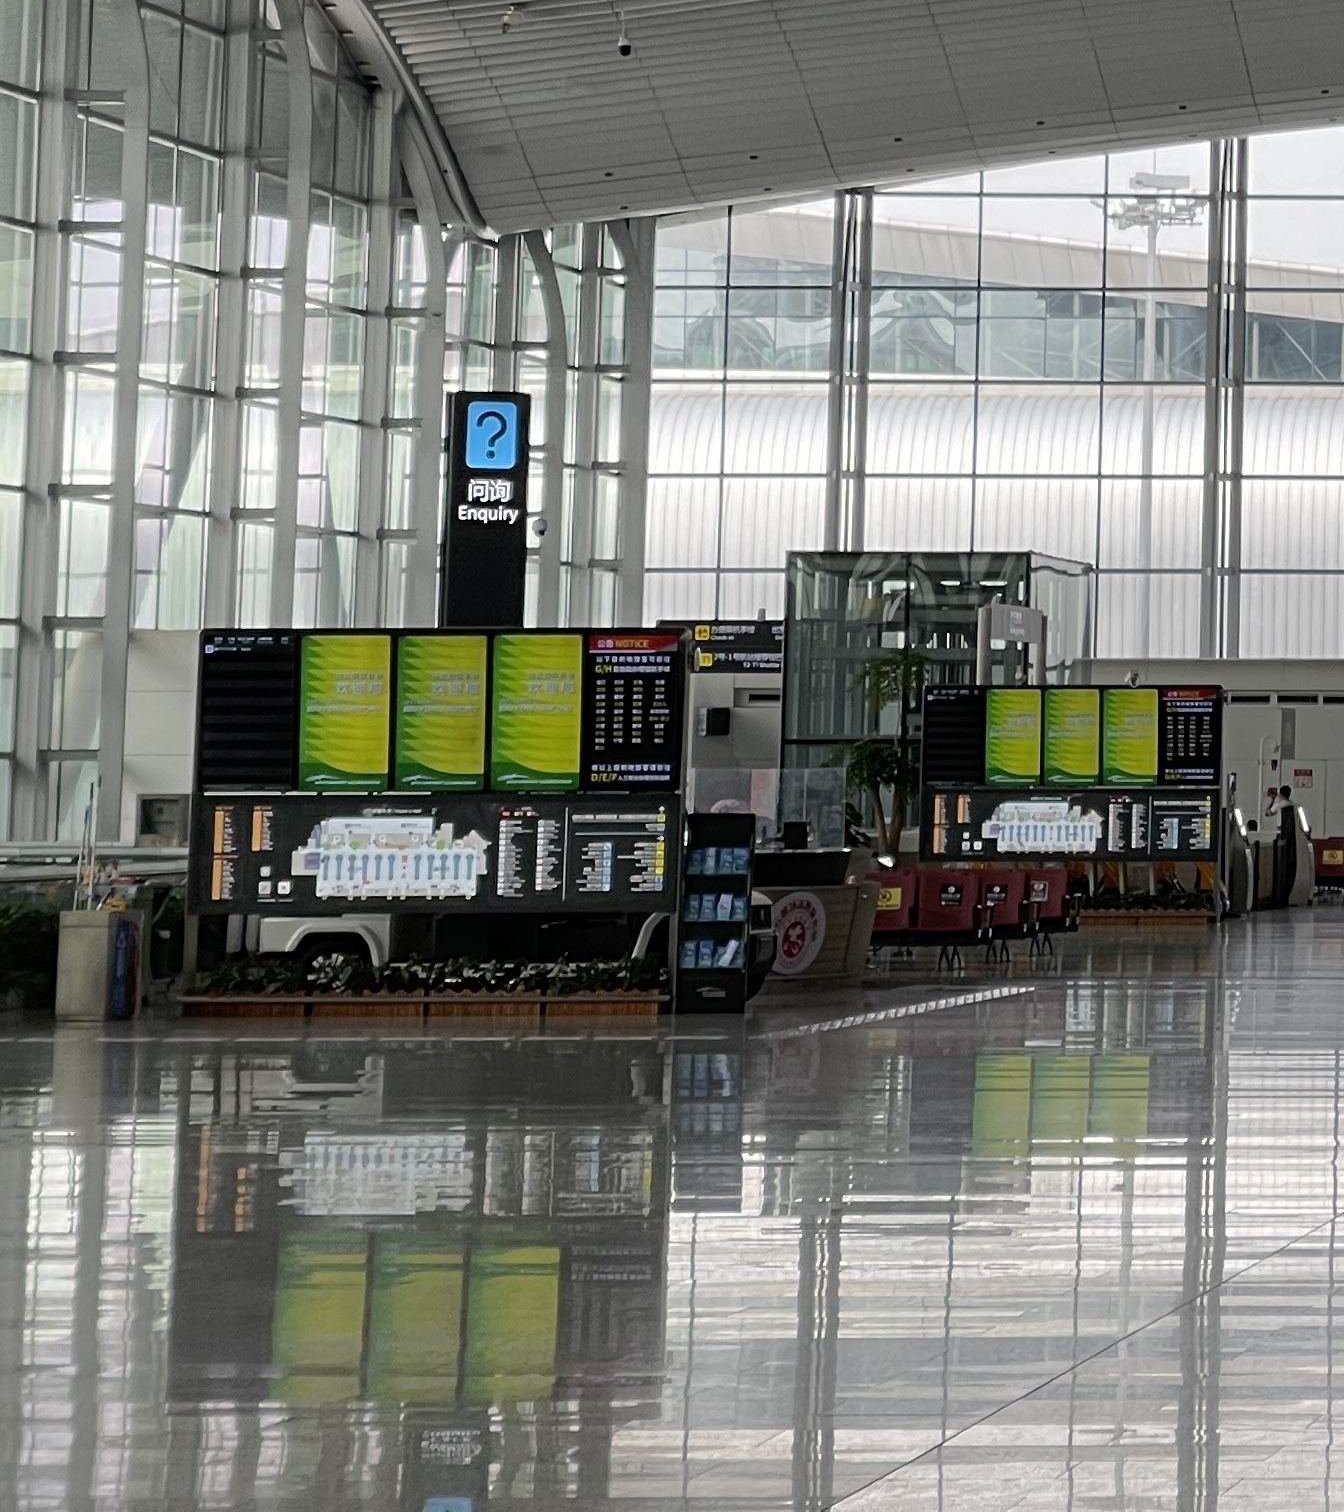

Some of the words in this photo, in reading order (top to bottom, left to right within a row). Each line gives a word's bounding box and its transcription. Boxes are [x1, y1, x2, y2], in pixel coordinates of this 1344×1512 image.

[467, 479, 513, 502] 问询
[458, 505, 519, 524] Enquiry
[615, 639, 649, 648] NOTICE
[595, 664, 612, 674] G/H
[591, 773, 617, 783] D/E/F
